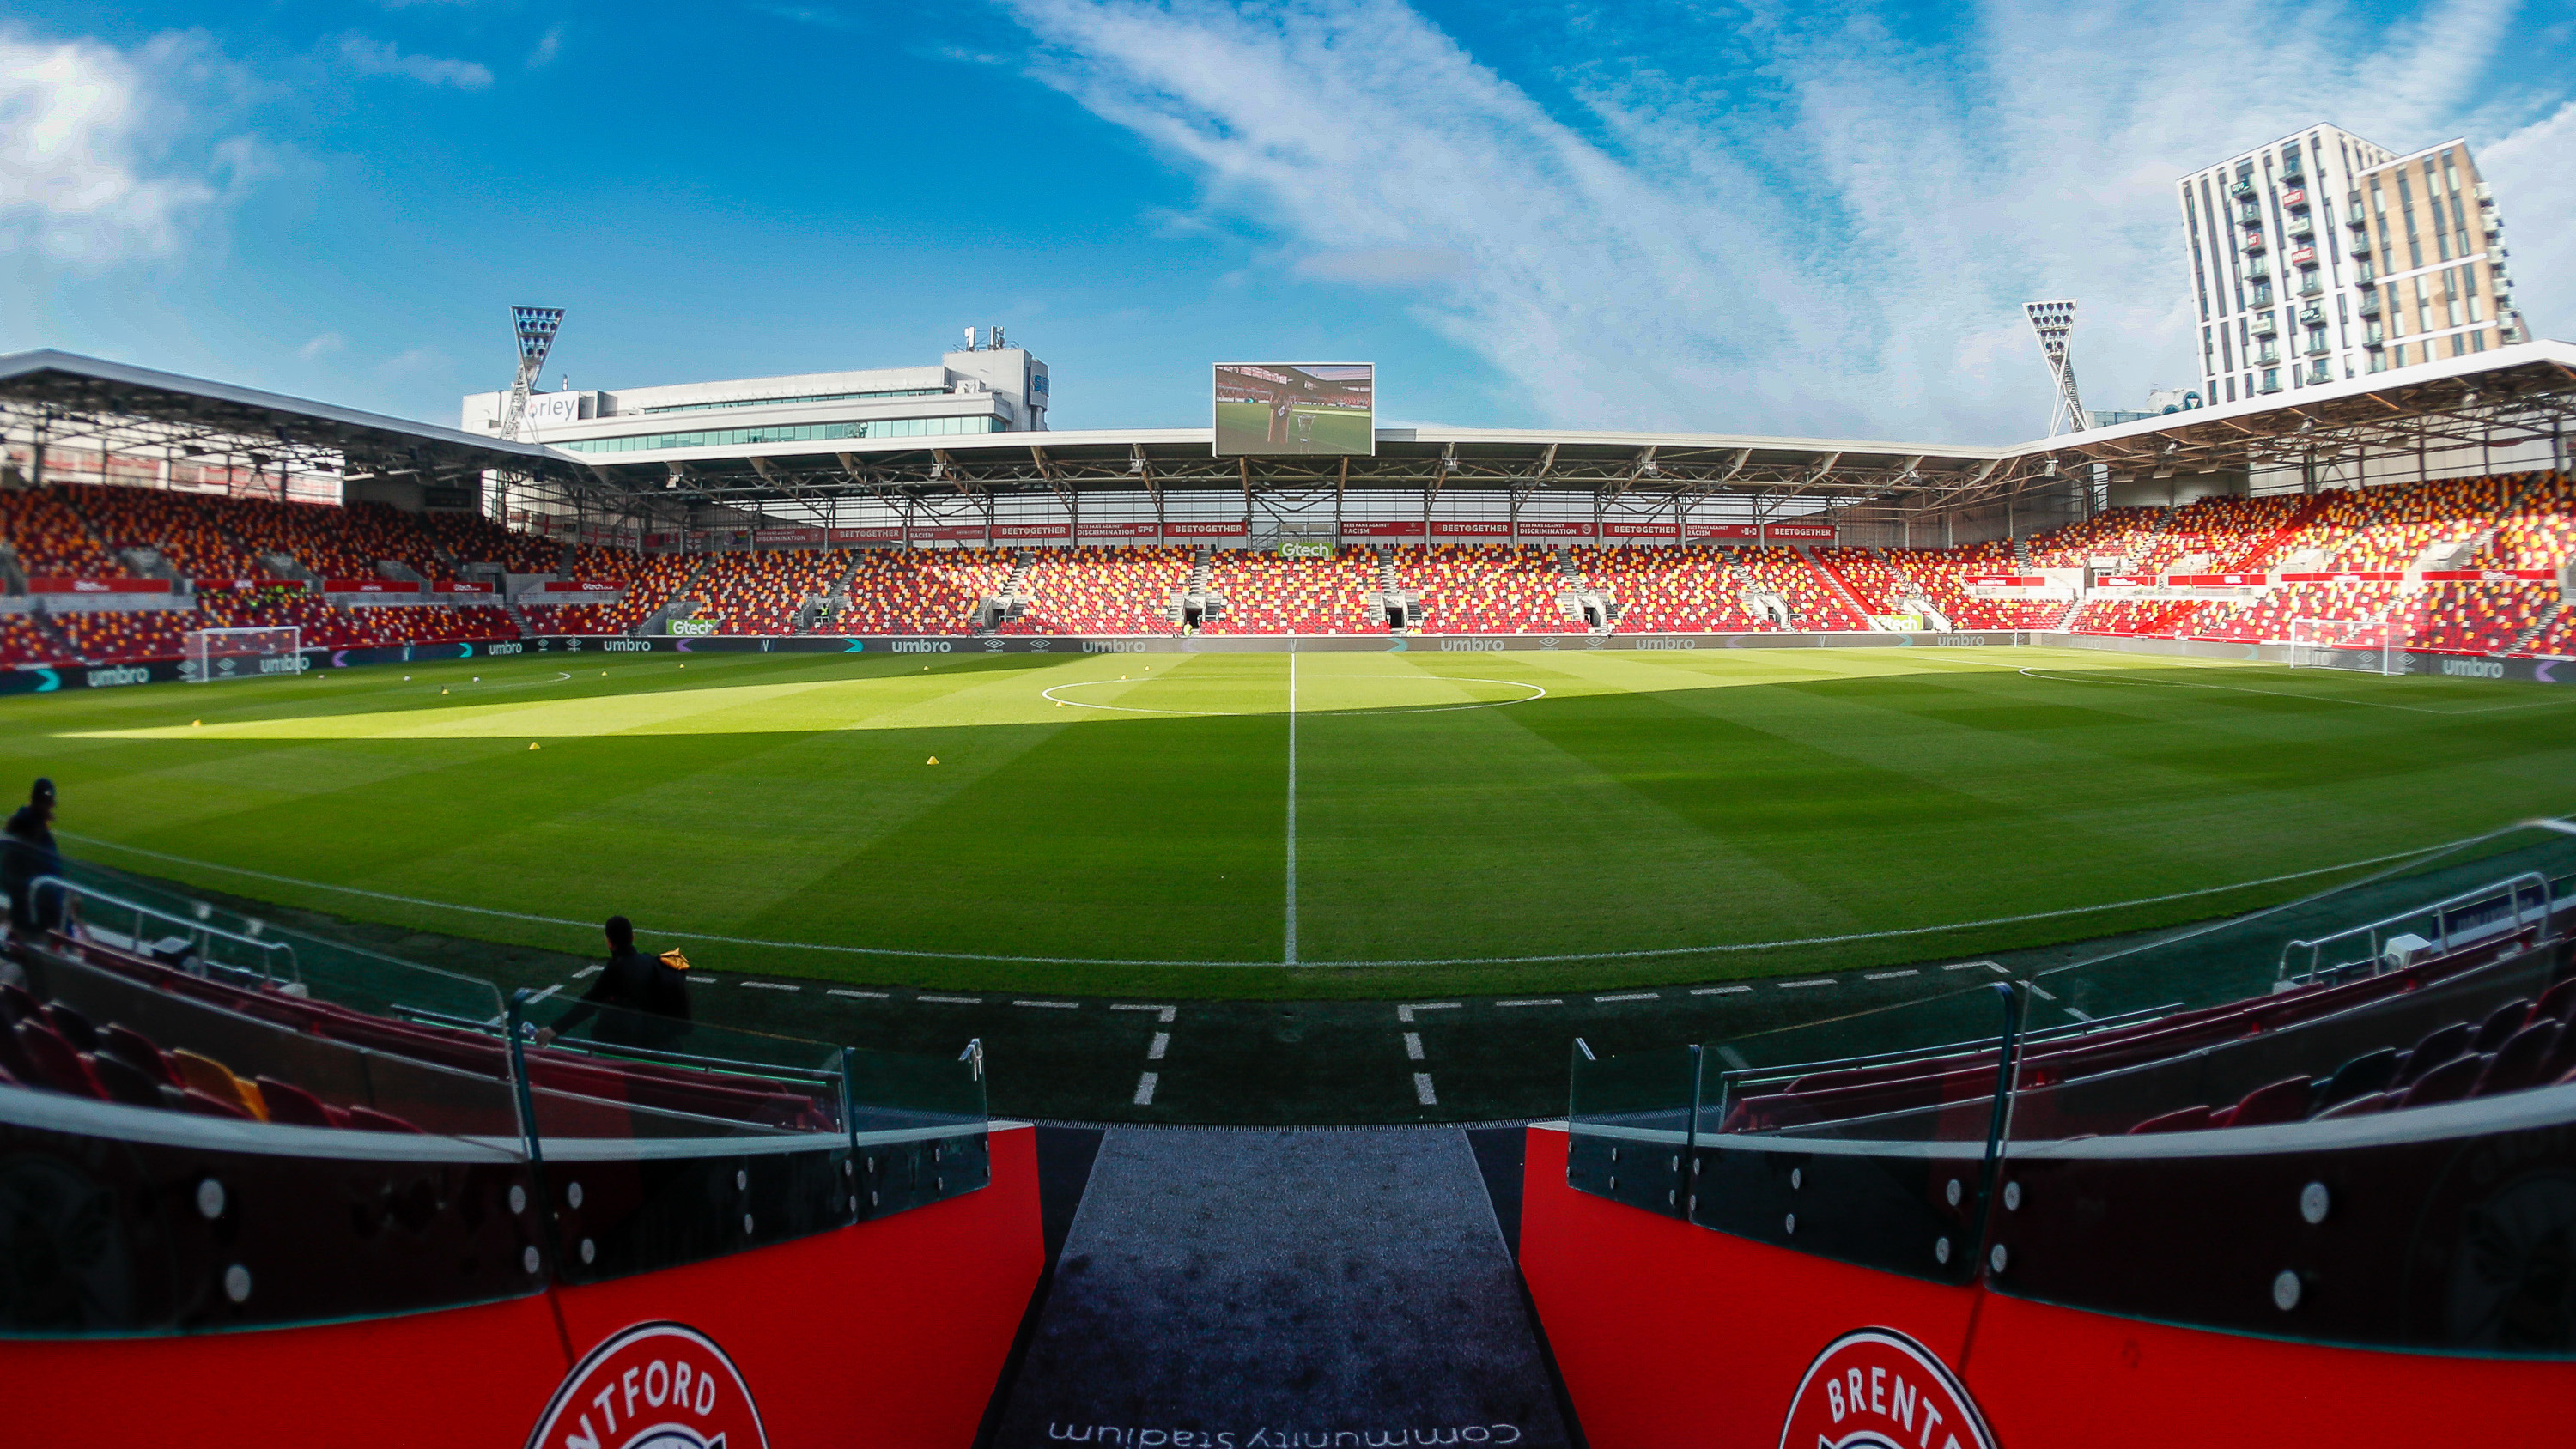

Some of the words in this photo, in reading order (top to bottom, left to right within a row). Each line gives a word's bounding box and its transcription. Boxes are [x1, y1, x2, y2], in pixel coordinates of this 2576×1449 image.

[528, 396, 575, 422] orley
[1175, 524, 1242, 534] BEETOGETHER
[1614, 525, 1676, 534] BEETOGETHER
[1774, 528, 1832, 537] BEETOGETHER
[1282, 543, 1329, 557] Gtech
[673, 620, 714, 635] Gtech
[604, 639, 651, 652] umbro
[892, 639, 951, 652] umbro
[1082, 639, 1146, 652] umbro
[1440, 638, 1504, 652] umbro
[1635, 636, 1696, 650] umbro
[1938, 634, 1985, 646] umbro
[489, 640, 523, 655] umbro
[260, 654, 310, 673] umbo
[2442, 657, 2505, 679] umbro
[87, 665, 150, 687] umbro
[565, 1359, 716, 1449] NTFORD
[1826, 1366, 1963, 1449] BRENT
